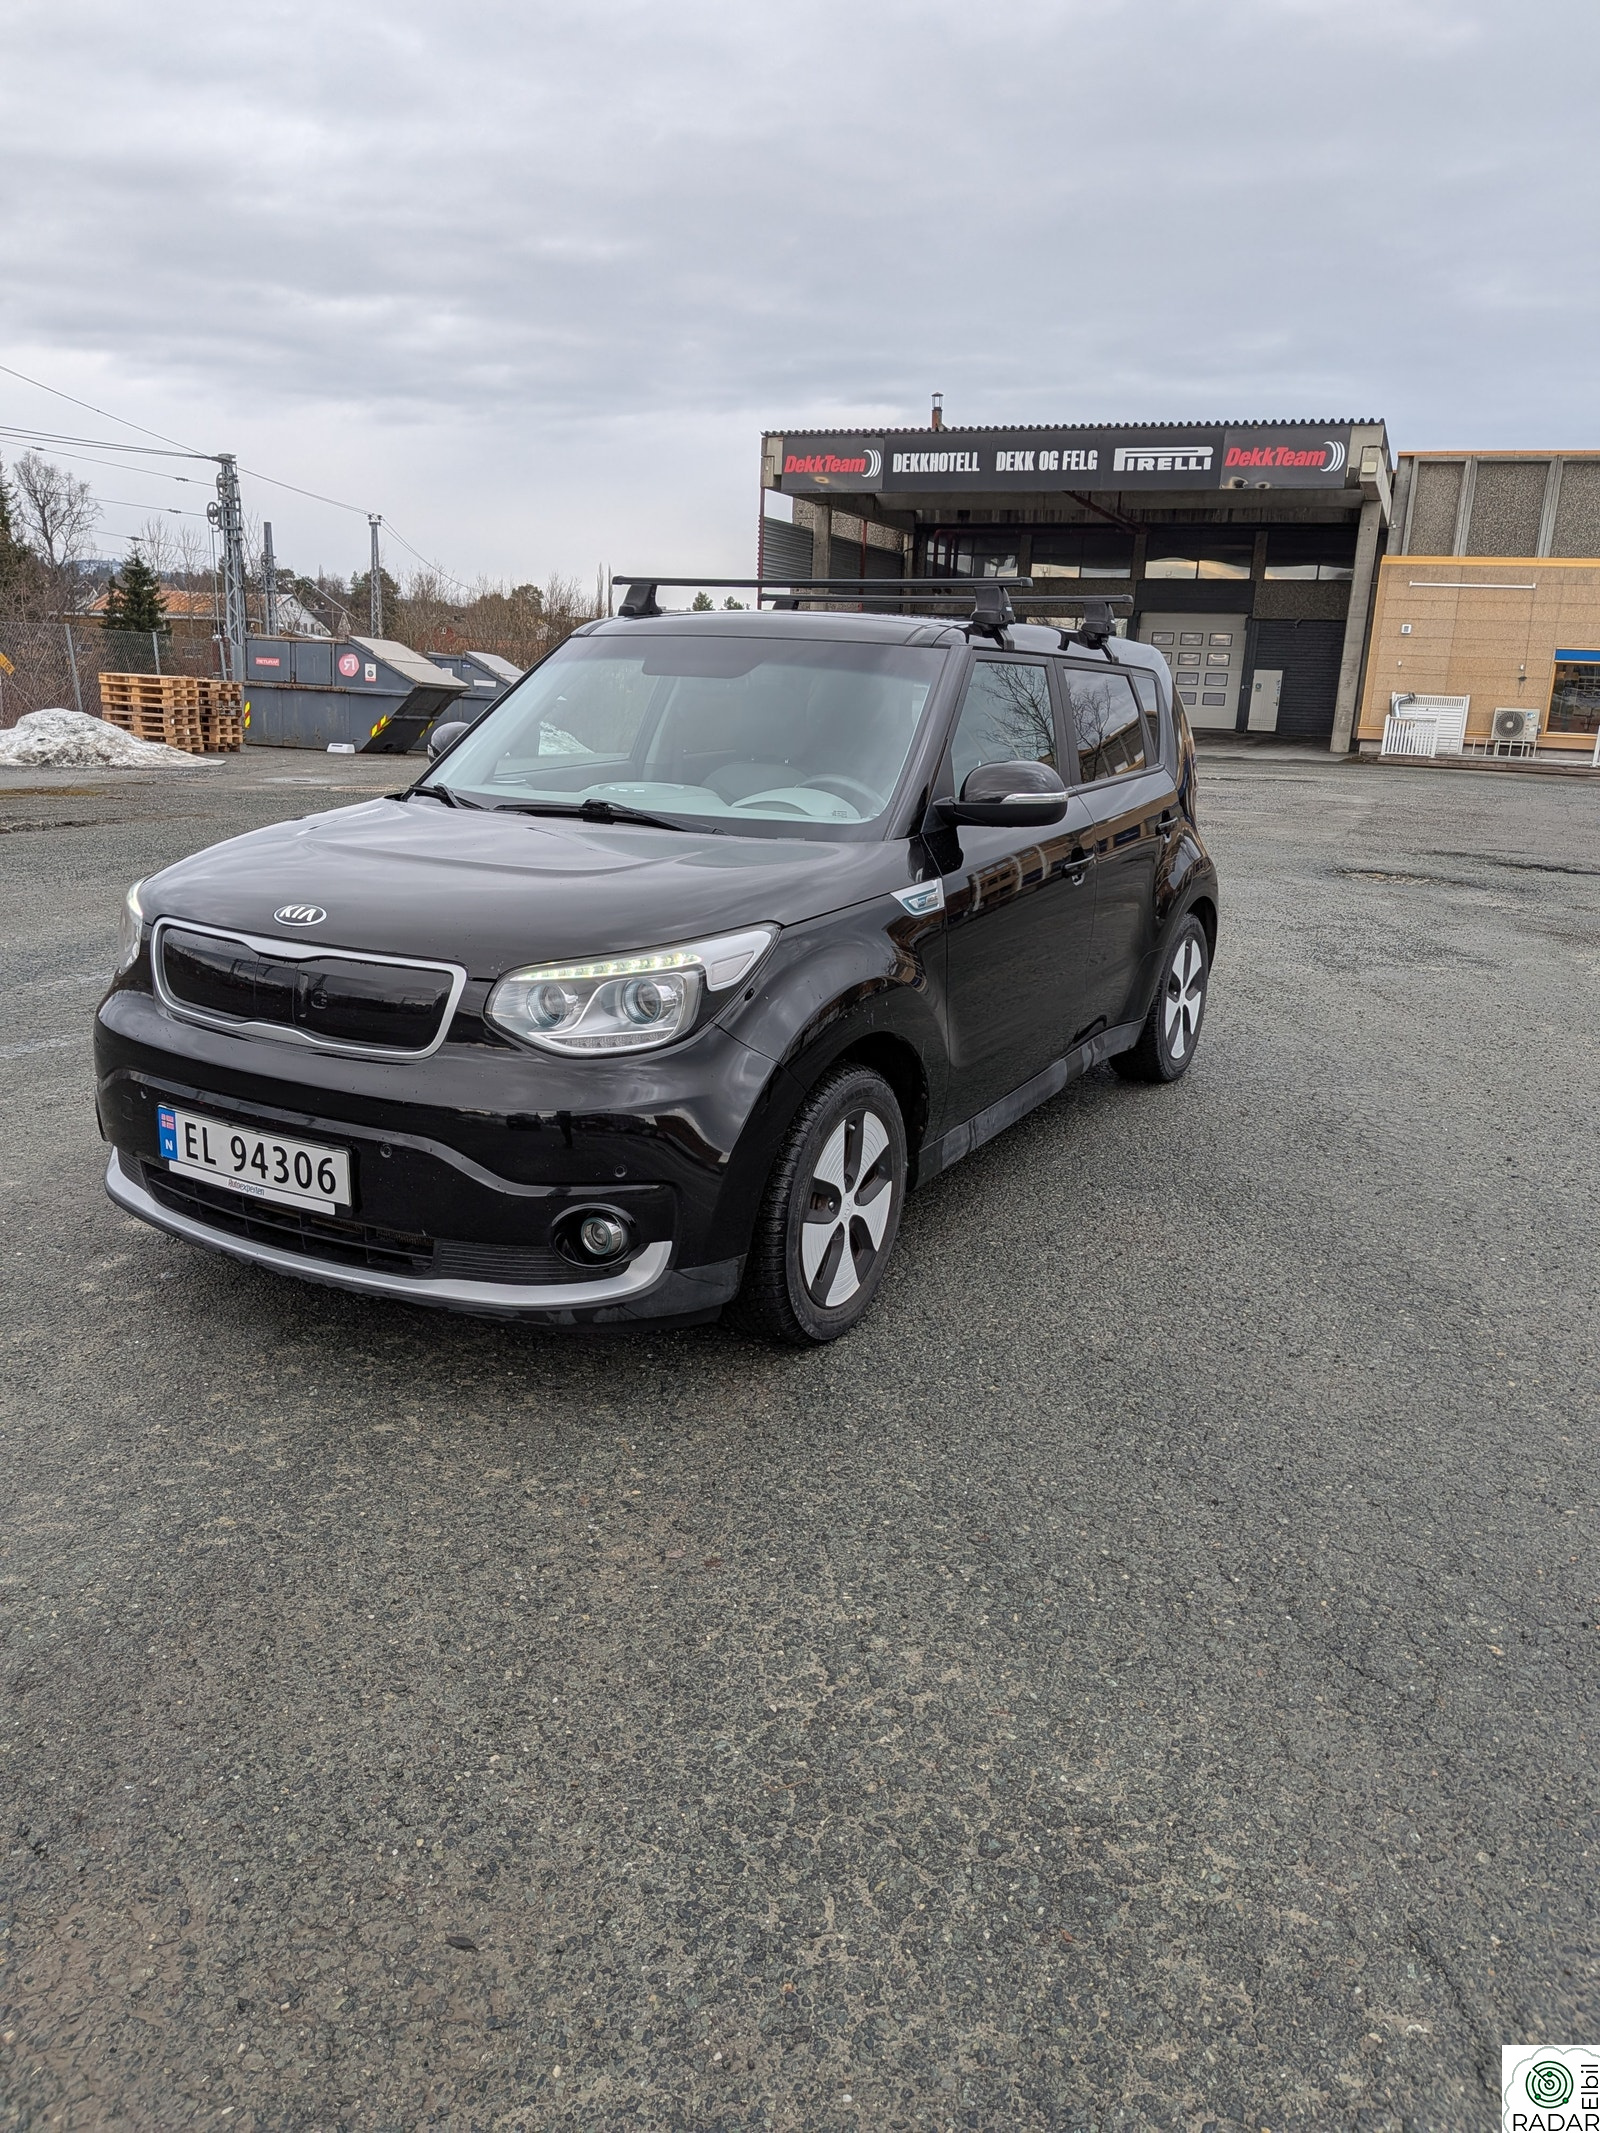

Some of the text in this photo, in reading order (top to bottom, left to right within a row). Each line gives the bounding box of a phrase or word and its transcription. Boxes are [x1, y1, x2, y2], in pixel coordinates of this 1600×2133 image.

[784, 454, 866, 473] DekkTeam
[892, 452, 980, 473] DEKKHOTELL
[995, 449, 1098, 472] DEKK OG FELG
[1113, 446, 1214, 472] PIRELLI
[1224, 446, 1327, 467] DekkTeam
[278, 905, 317, 922] KIA
[165, 1138, 173, 1151] N
[184, 1121, 337, 1195] EL 94306
